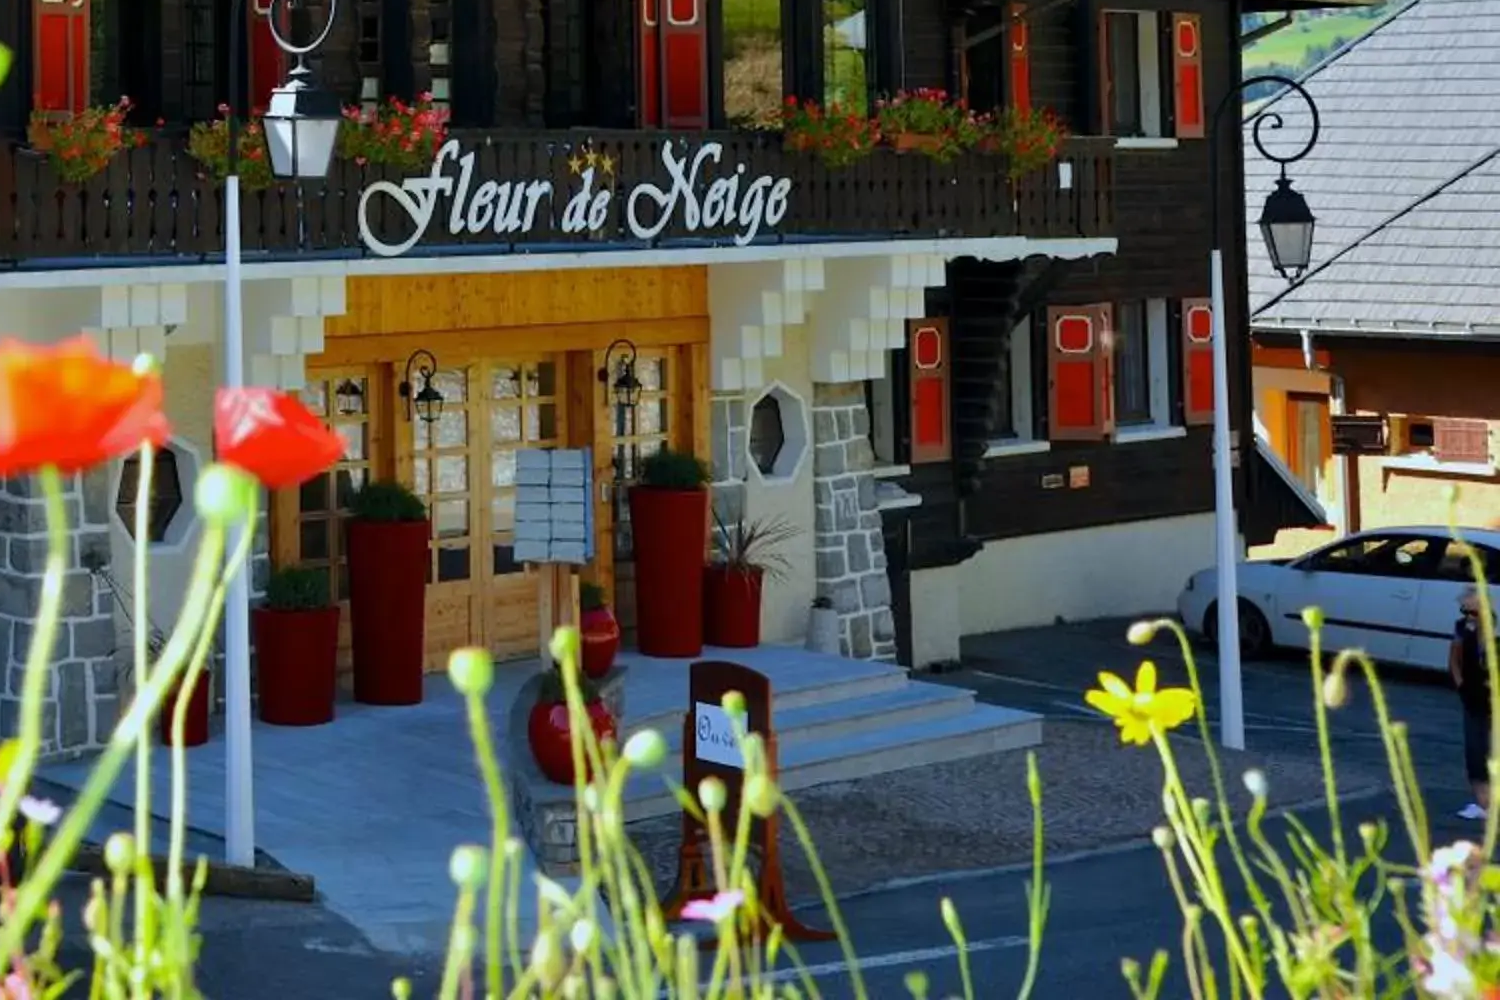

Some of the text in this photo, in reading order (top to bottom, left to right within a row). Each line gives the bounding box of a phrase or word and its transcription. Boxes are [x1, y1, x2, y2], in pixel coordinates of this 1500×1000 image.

[357, 139, 792, 257] Fleur de Neige
